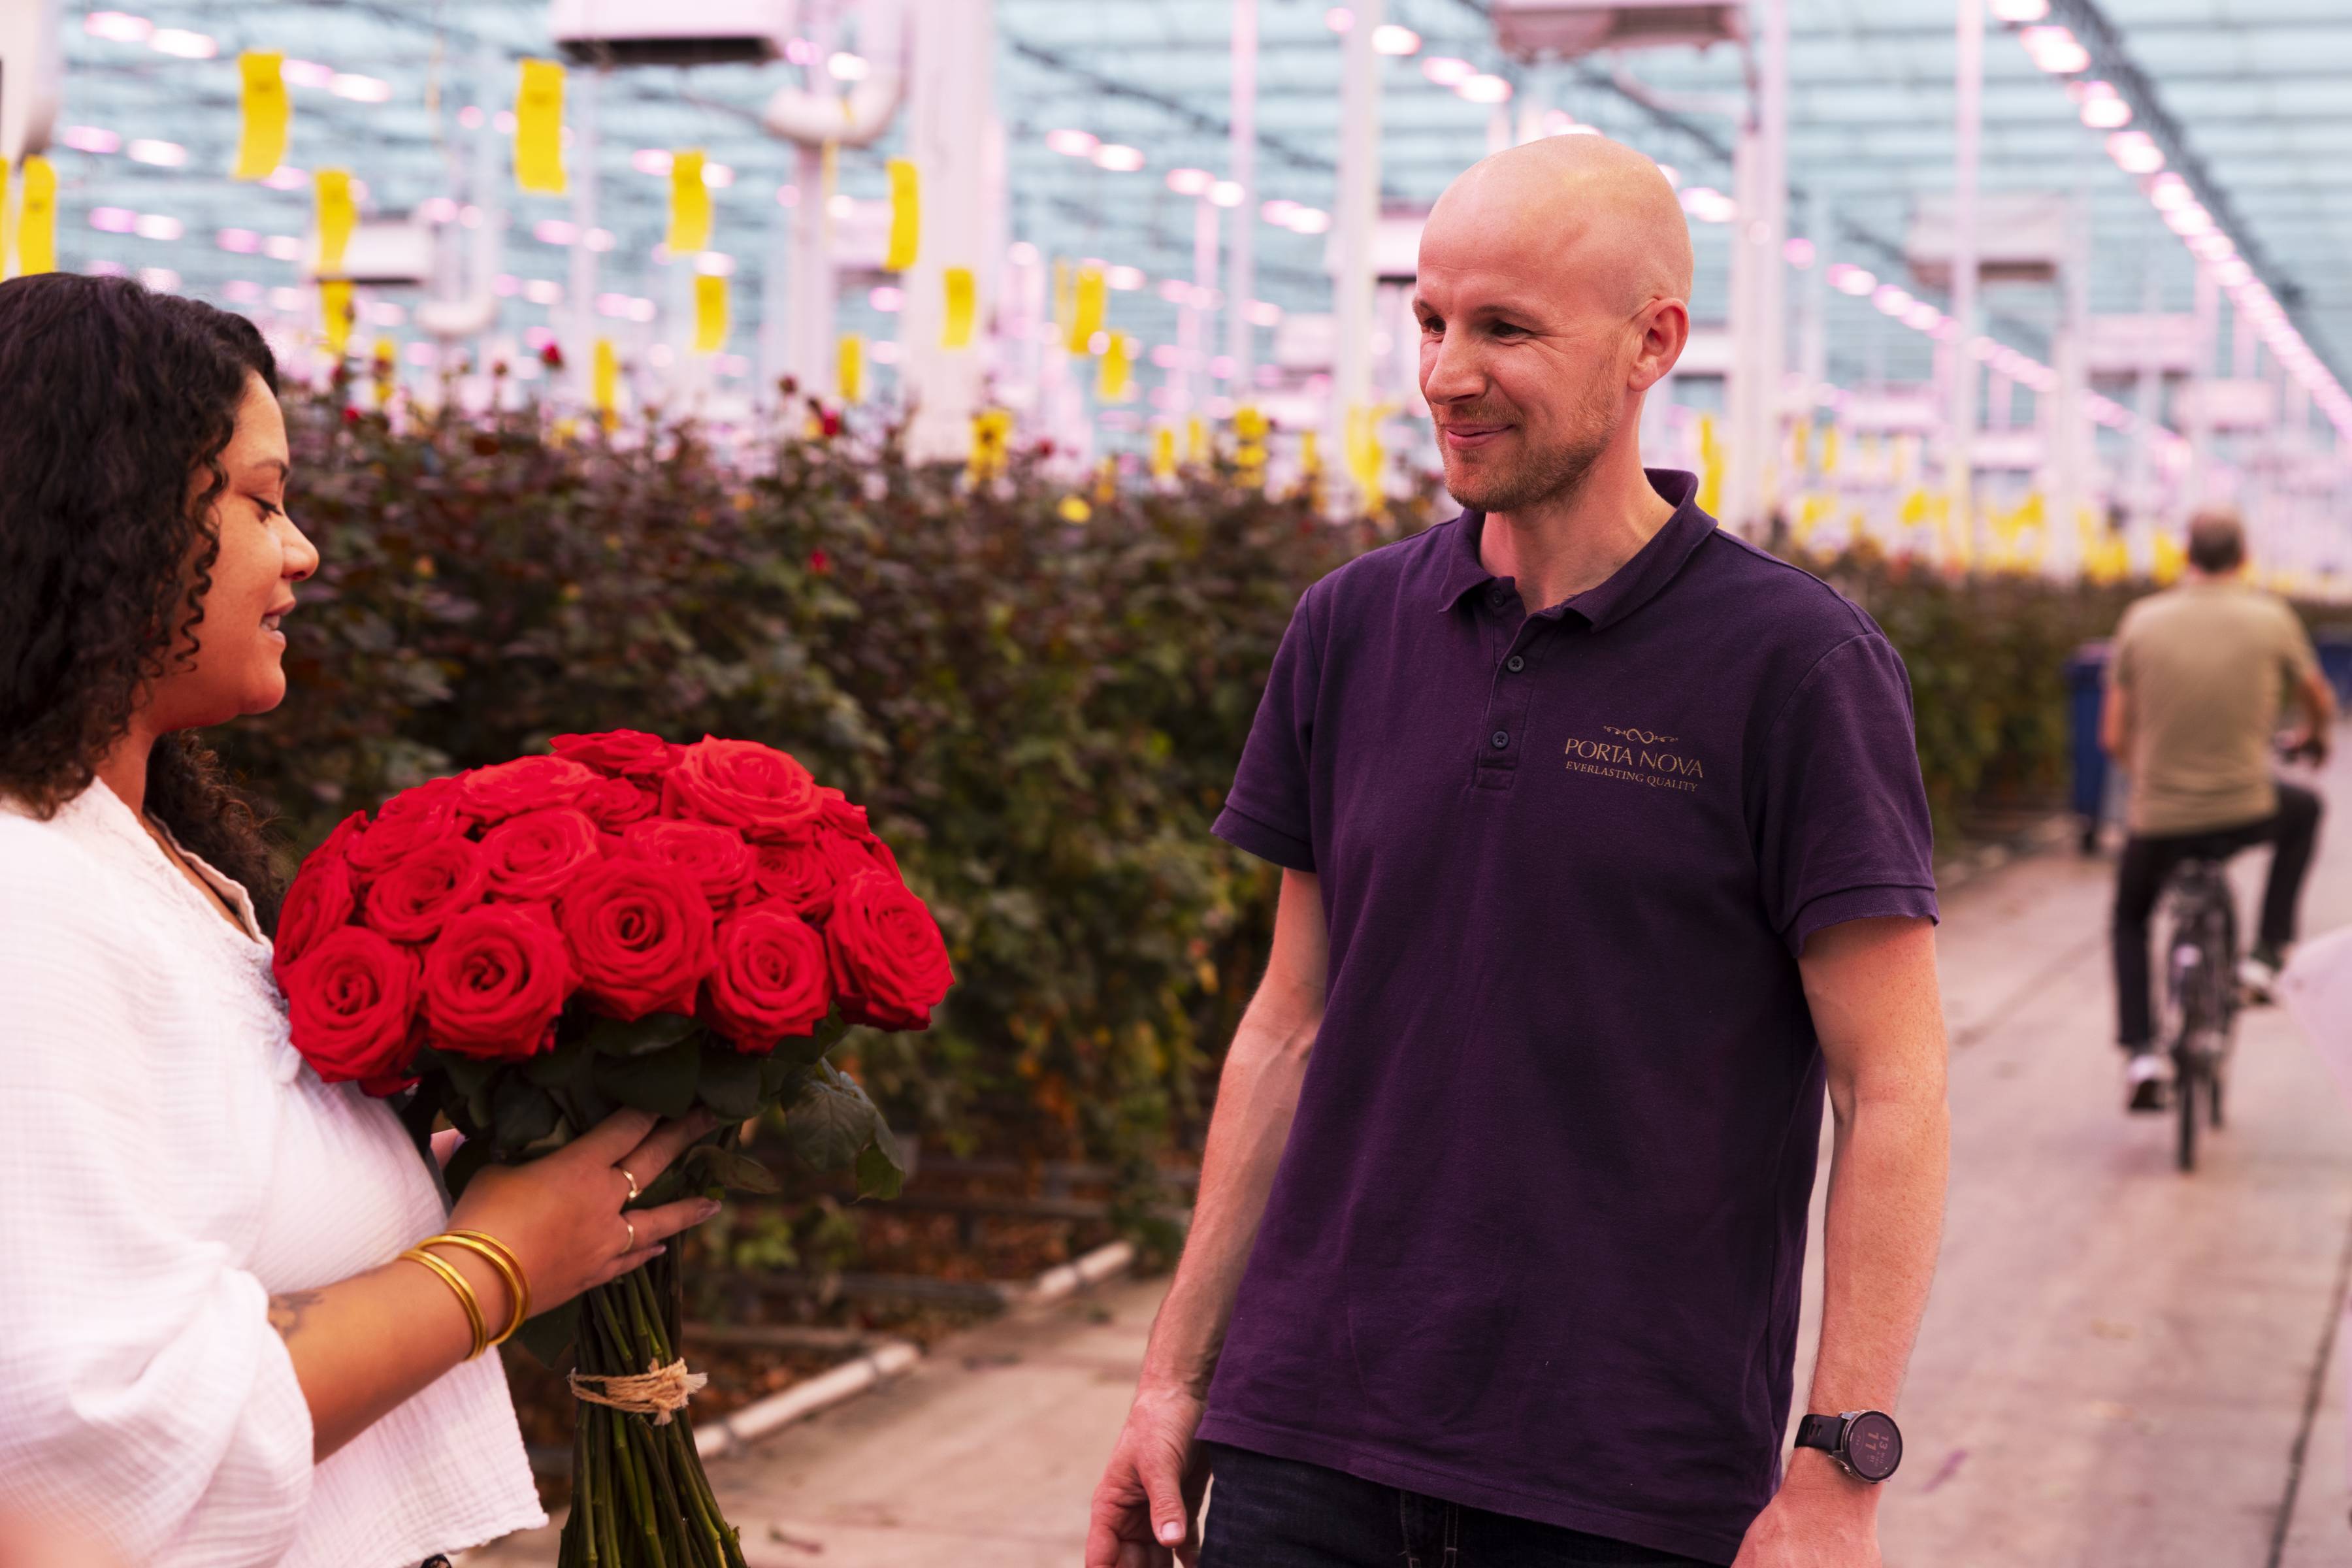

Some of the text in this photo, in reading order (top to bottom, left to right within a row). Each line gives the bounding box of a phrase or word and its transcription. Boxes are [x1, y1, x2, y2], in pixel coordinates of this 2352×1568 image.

[1565, 738, 1703, 778] PORTA NOVA
[1566, 761, 1698, 792] EVERLASTING QUALITY
